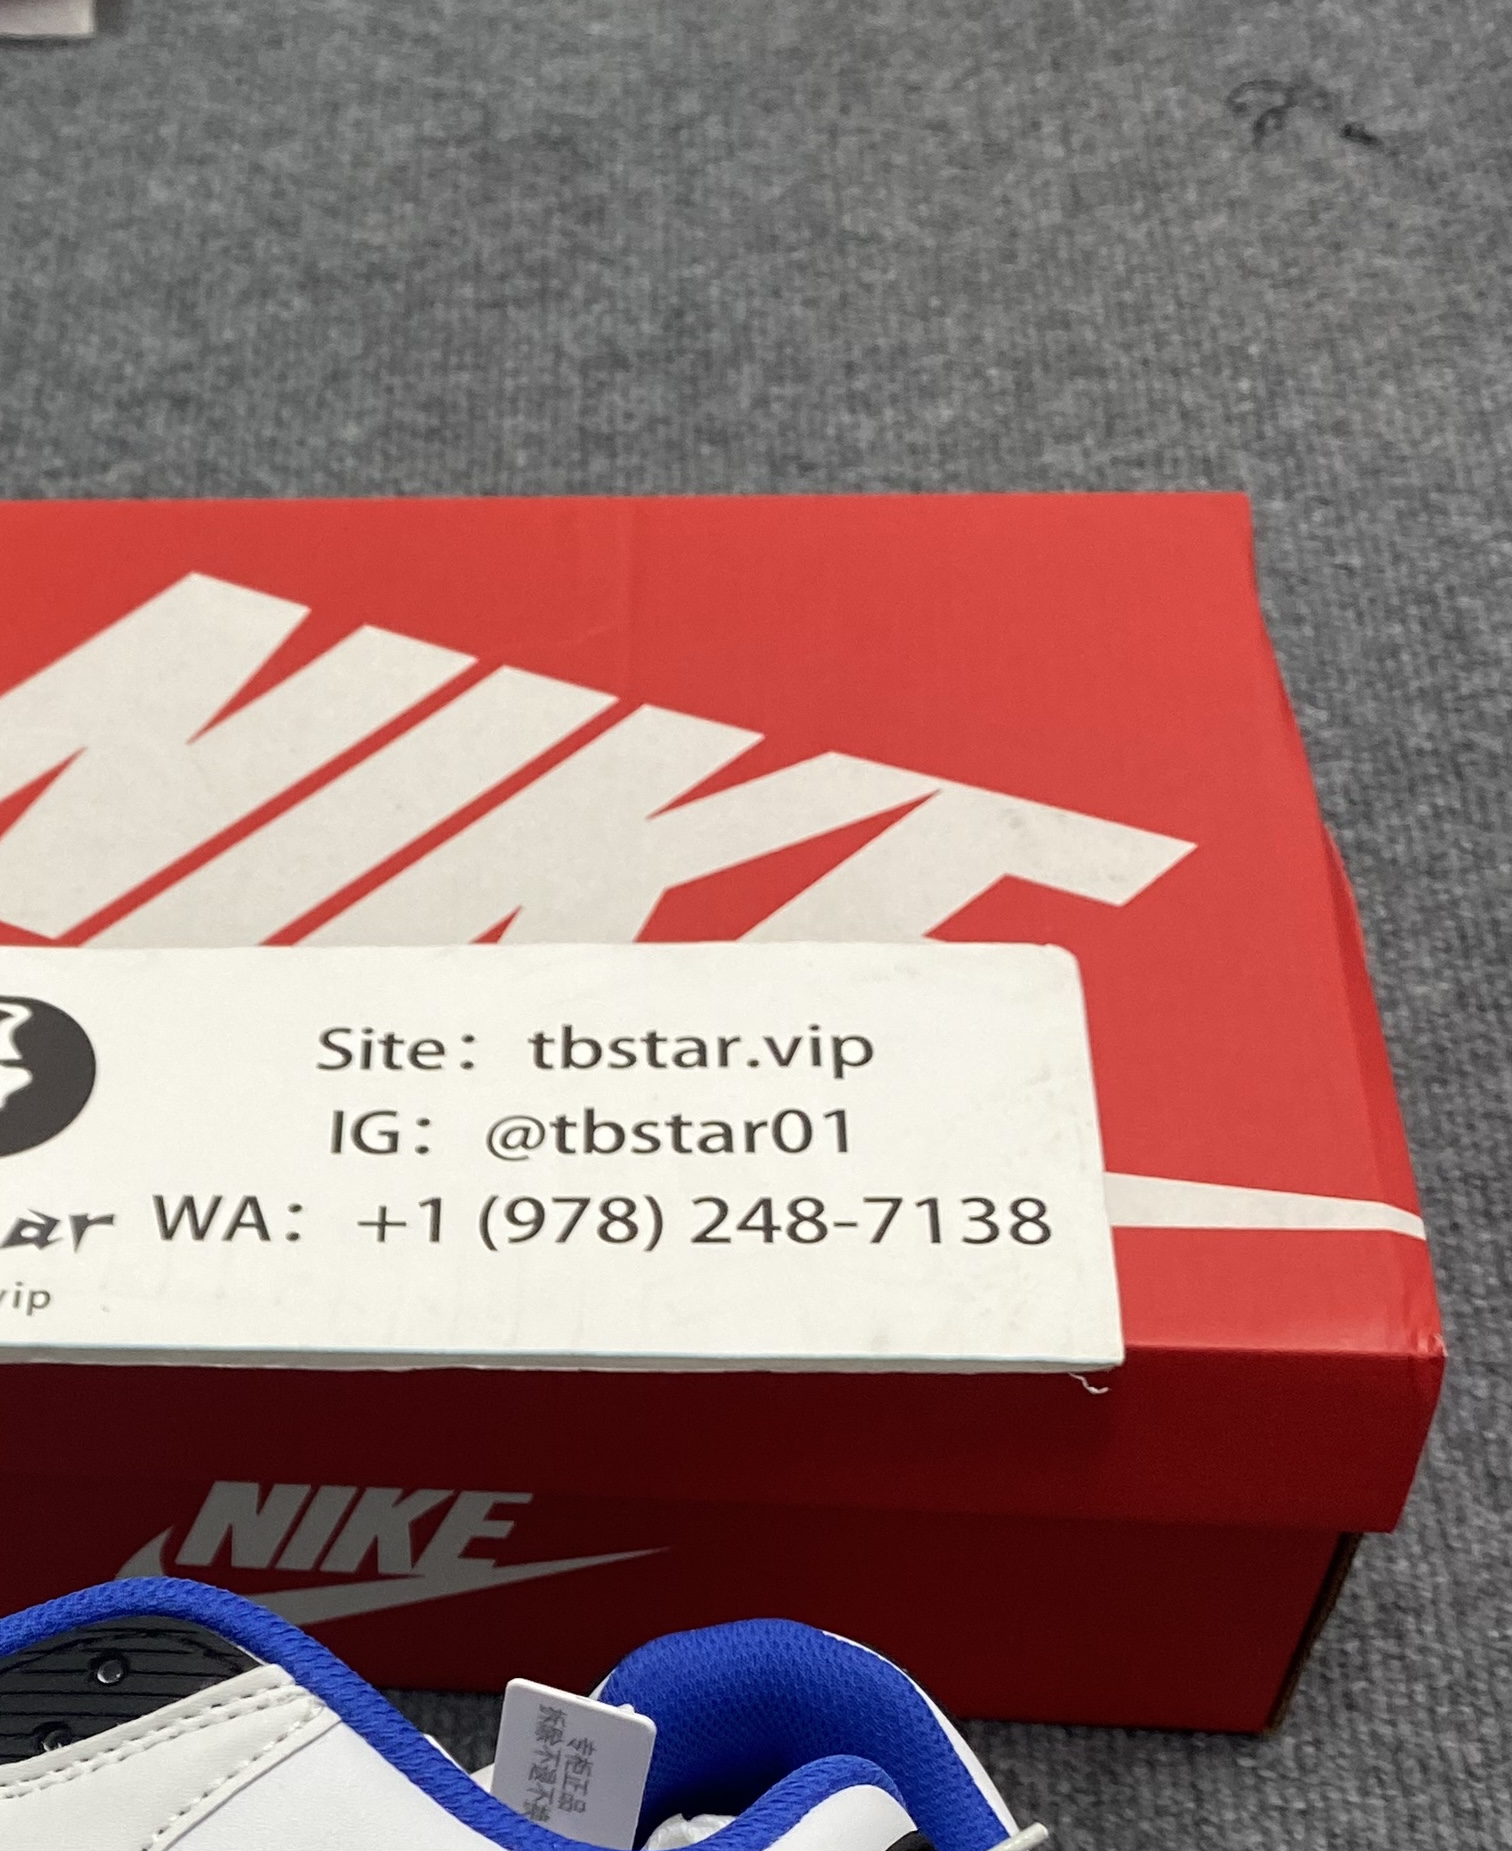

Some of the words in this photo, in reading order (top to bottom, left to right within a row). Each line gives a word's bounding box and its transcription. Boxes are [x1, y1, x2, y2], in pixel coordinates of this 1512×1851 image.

[316, 1023, 476, 1073] Site:
[528, 1023, 876, 1082] tbstar.vip
[330, 1108, 432, 1157] IG:
[486, 1108, 851, 1163] @tbstar01
[152, 1194, 304, 1245] WA:
[356, 1196, 445, 1246] +1
[478, 1194, 665, 1254] (978)
[690, 1194, 1054, 1248] 248-7138
[174, 1480, 534, 1576] NIKE
[557, 1736, 597, 1814] 专柜正品
